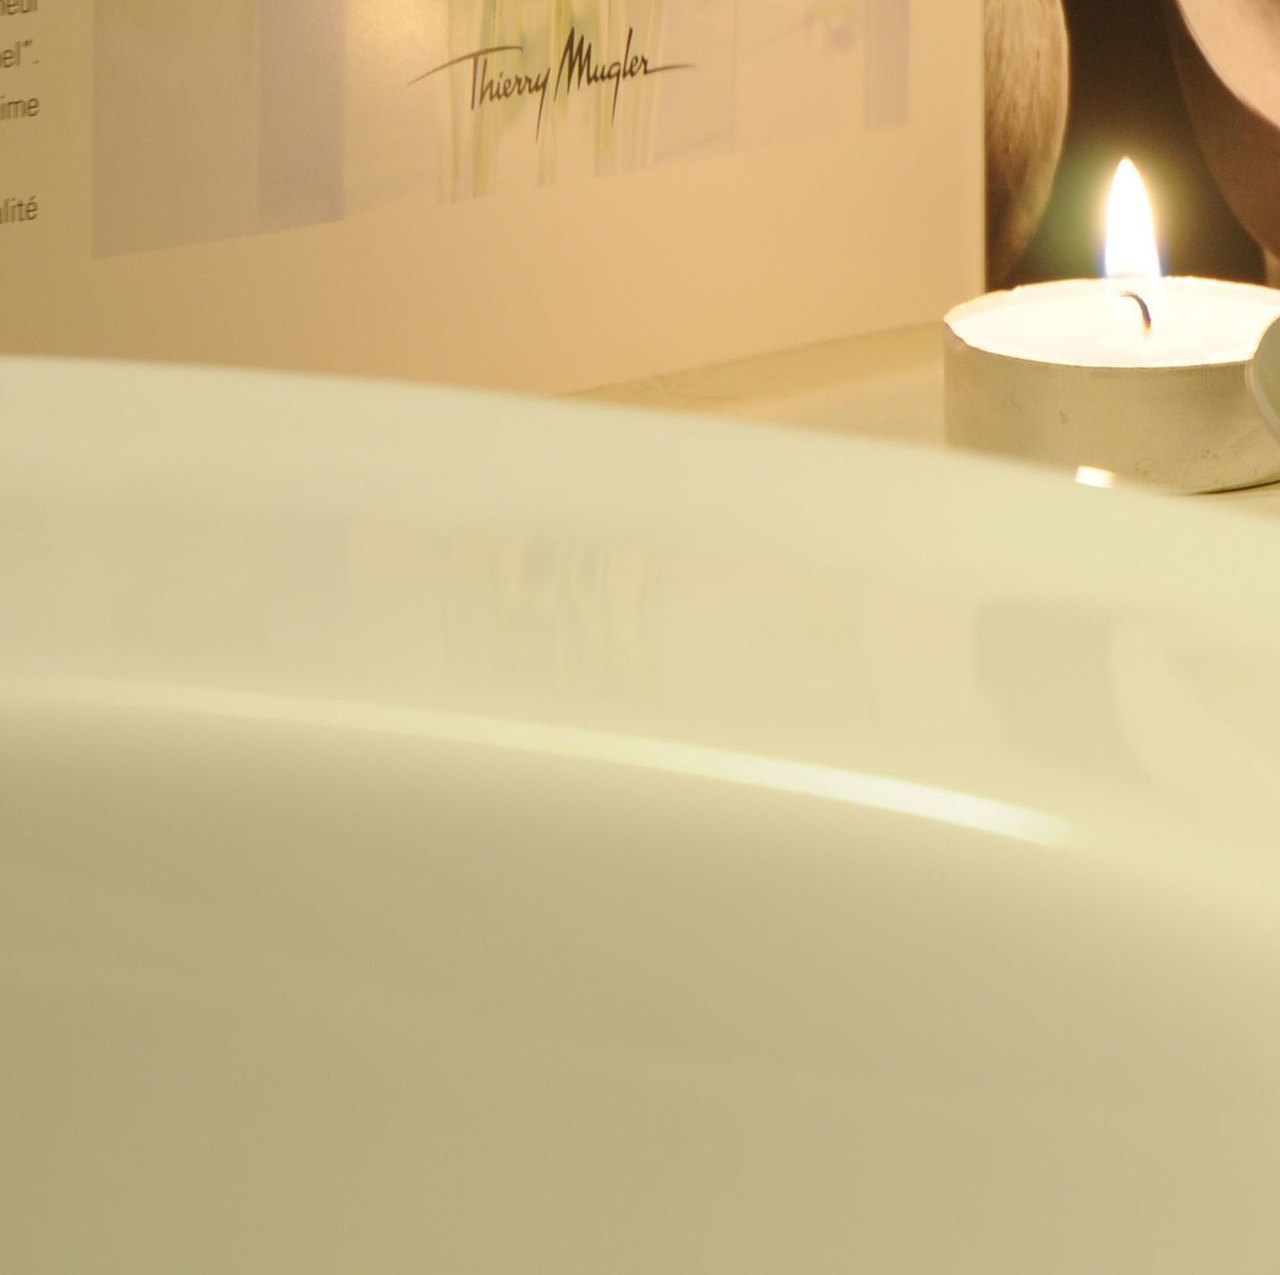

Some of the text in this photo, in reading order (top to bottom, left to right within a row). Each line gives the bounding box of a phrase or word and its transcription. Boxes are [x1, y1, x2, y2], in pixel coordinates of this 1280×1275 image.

[406, 26, 698, 144] Thierry Mugler
[0, 195, 38, 223] lité
